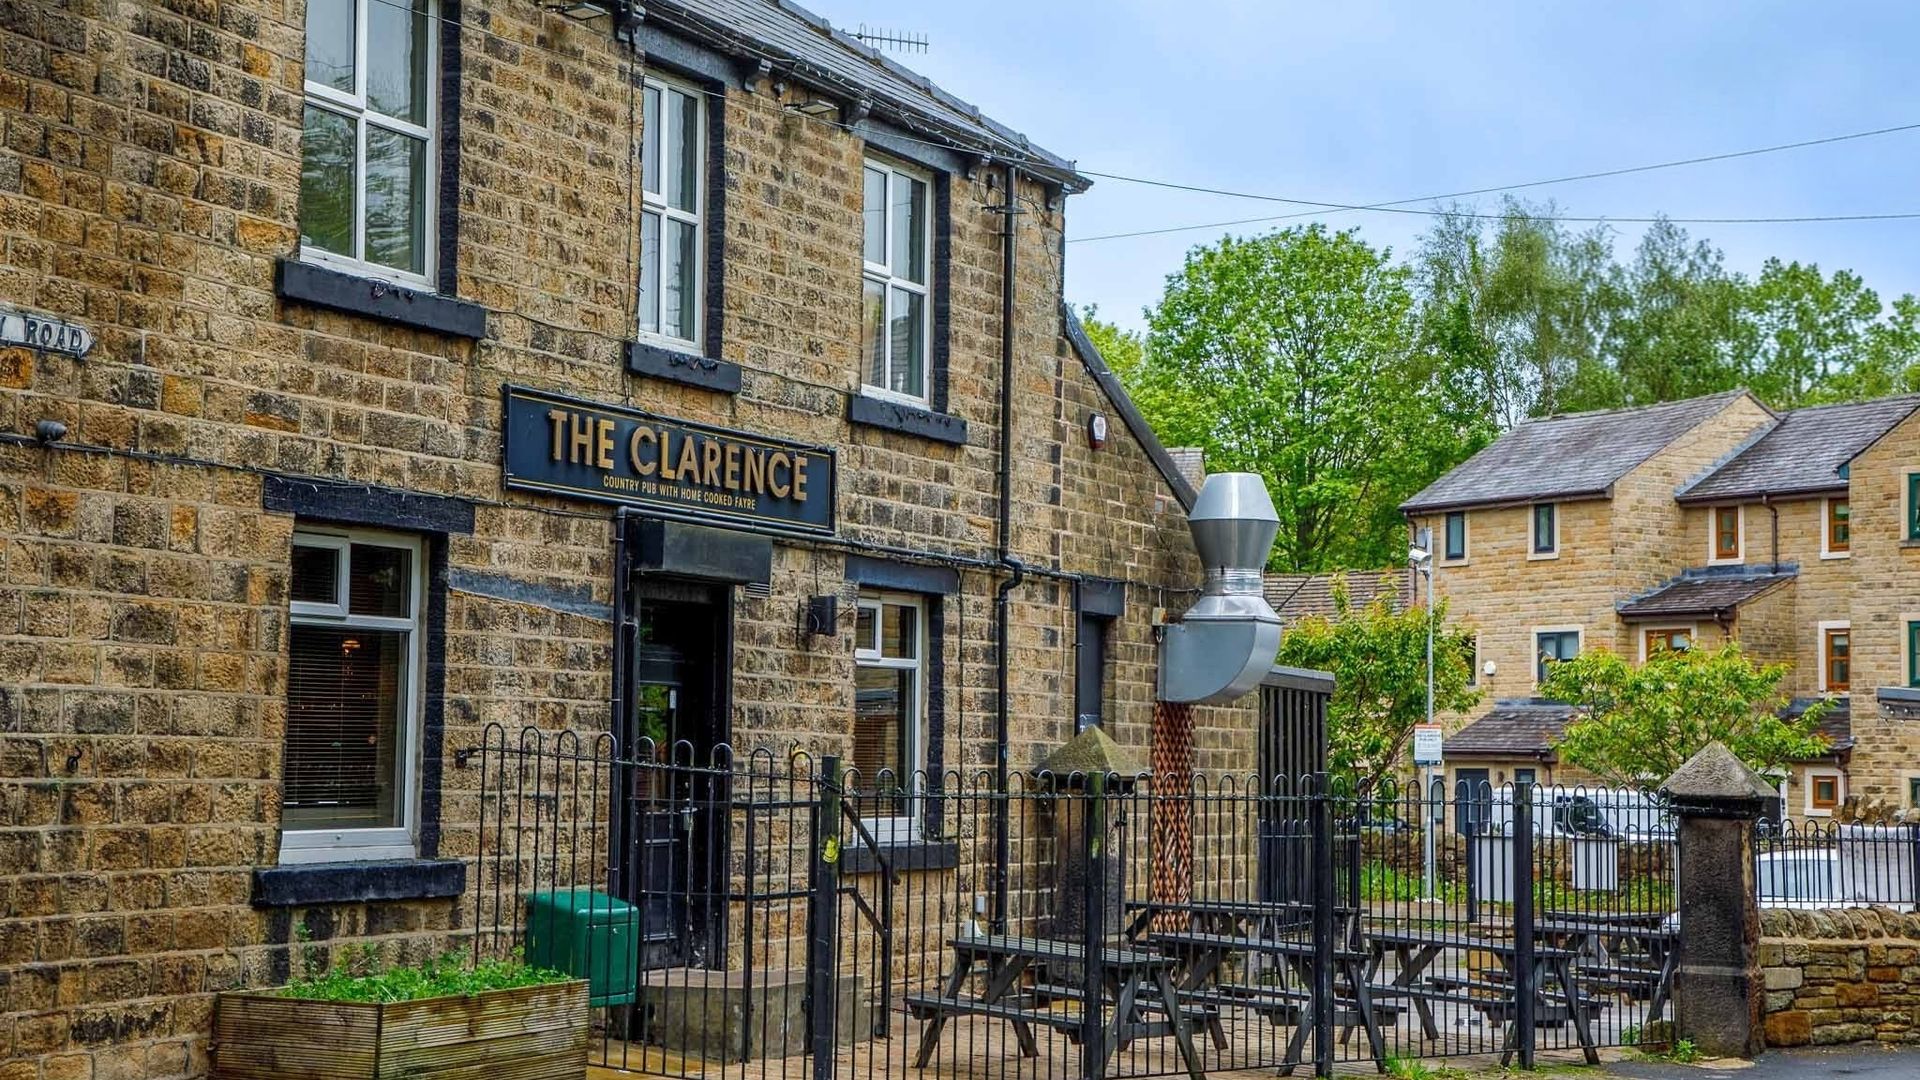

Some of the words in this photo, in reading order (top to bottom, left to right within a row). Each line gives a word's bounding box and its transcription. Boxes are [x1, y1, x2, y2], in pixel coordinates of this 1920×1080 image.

[26, 320, 82, 350] ROAD
[549, 409, 615, 469] THE
[630, 426, 807, 500] CLARENCE
[603, 475, 639, 491] COUNTRY
[641, 481, 657, 494] PUB
[659, 484, 678, 498] WITH
[680, 487, 701, 501] HOME
[703, 491, 733, 506] COOKED
[734, 496, 756, 510] FAYRE
